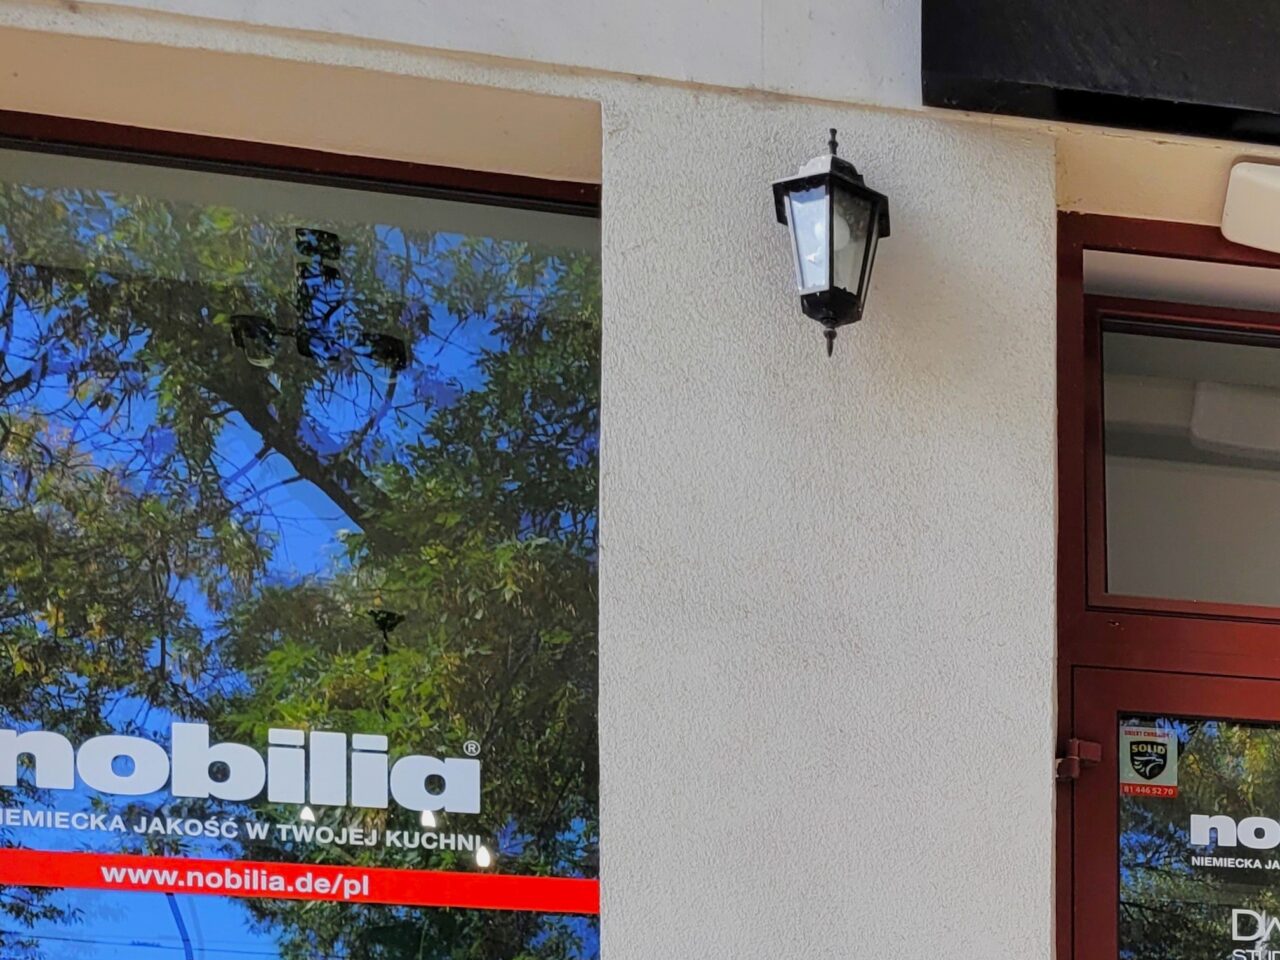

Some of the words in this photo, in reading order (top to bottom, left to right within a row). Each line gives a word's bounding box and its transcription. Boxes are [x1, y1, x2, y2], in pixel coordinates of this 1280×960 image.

[1131, 743, 1165, 755] SOLID
[0, 808, 127, 833] IEMIECKA
[133, 815, 239, 839] JAKOŚĆ
[245, 822, 270, 841] W
[276, 823, 378, 847] TWOJEJ
[385, 830, 482, 852] KUCHNI
[1191, 855, 1262, 870] NIEMIECKA
[100, 865, 370, 899] www.nobilia.de/pl
